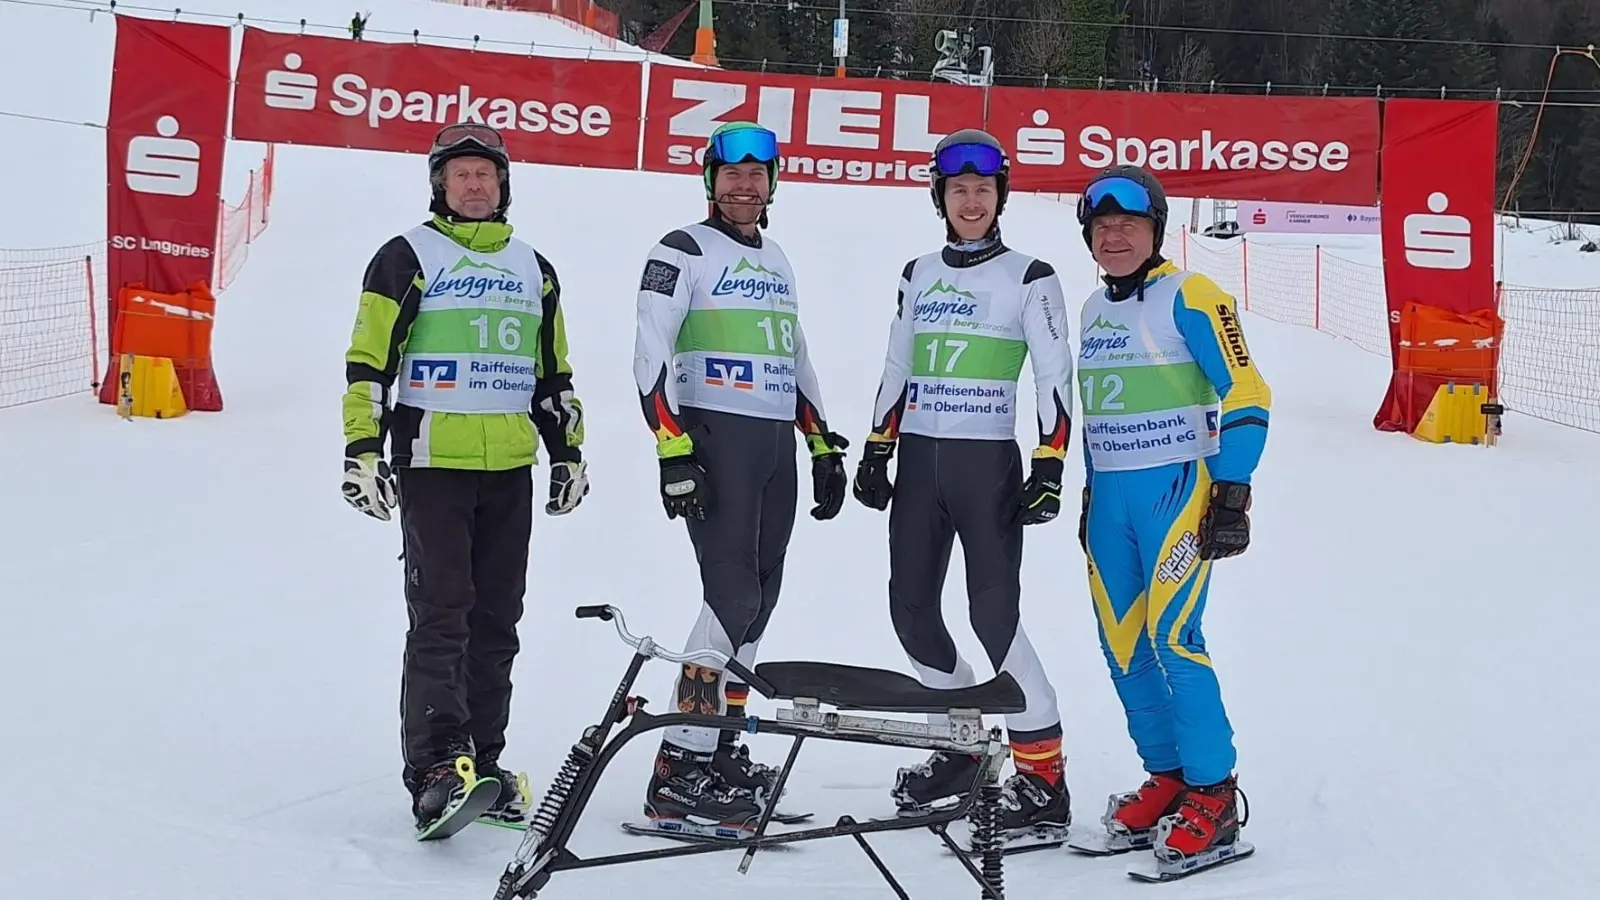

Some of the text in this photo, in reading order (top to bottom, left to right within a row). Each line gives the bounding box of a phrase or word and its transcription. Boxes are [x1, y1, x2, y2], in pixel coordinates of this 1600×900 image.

[329, 73, 612, 137] Sparkasse
[668, 78, 948, 152] ZIEL
[1079, 125, 1350, 171] Sparkasse
[112, 235, 136, 250] SC
[424, 267, 524, 298] Lenggries
[711, 266, 790, 301] Lenggries
[469, 313, 522, 352] 16
[757, 316, 795, 353] 18
[1215, 303, 1250, 368] Skibob
[926, 338, 969, 373] 17
[468, 377, 487, 390] im
[765, 379, 780, 392] im
[923, 383, 1006, 398] Raiffeisenbank
[1082, 373, 1125, 411] 12
[921, 400, 1009, 414] im Oberland eG
[1103, 434, 1172, 452] Oberland
[1176, 429, 1197, 443] eG
